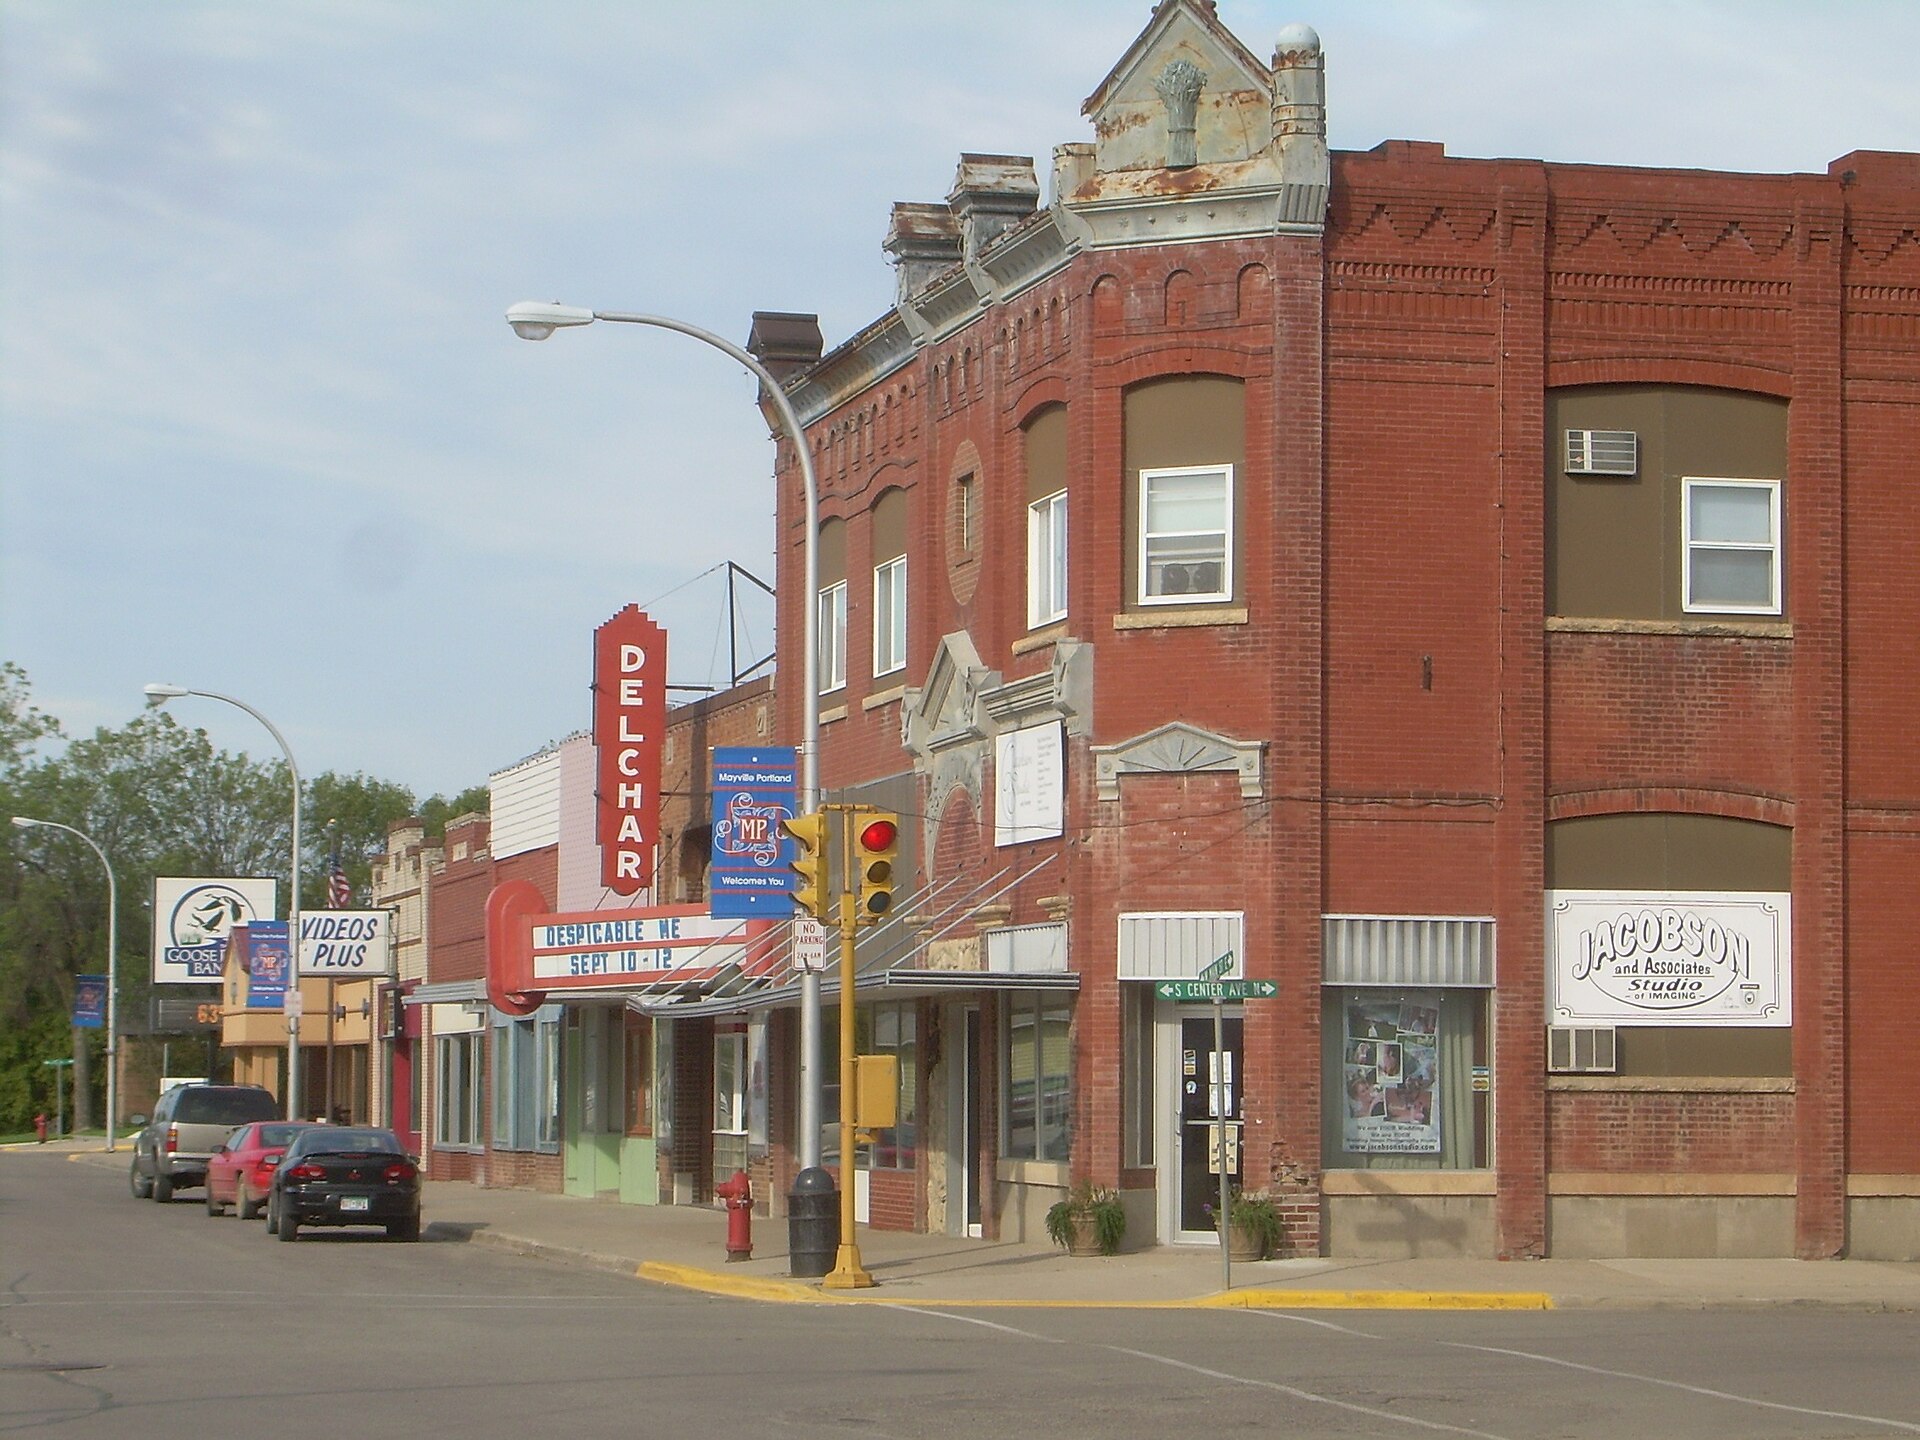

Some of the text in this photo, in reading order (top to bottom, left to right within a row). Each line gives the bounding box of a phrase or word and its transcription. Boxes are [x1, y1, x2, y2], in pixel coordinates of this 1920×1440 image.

[616, 644, 646, 879] DELCHAR
[718, 773, 792, 784] Mayville Portland
[740, 818, 768, 840] MP
[721, 876, 785, 886] Welcomes You
[302, 917, 378, 940] VIDEOS
[546, 918, 681, 946] DESPICABLE ME
[803, 924, 815, 933] NO
[796, 936, 824, 944] PARKING
[1572, 908, 1750, 980] JACOBSON
[167, 949, 218, 961] GOOSE
[313, 943, 367, 967] PLUS
[194, 963, 222, 975] BAN
[570, 953, 608, 975] SEPT
[1614, 956, 1711, 975] and Associates
[1175, 981, 1261, 997] S CENTER AVE N
[1628, 979, 1703, 991] Studio
[1634, 991, 1697, 1000] of IMAGING
